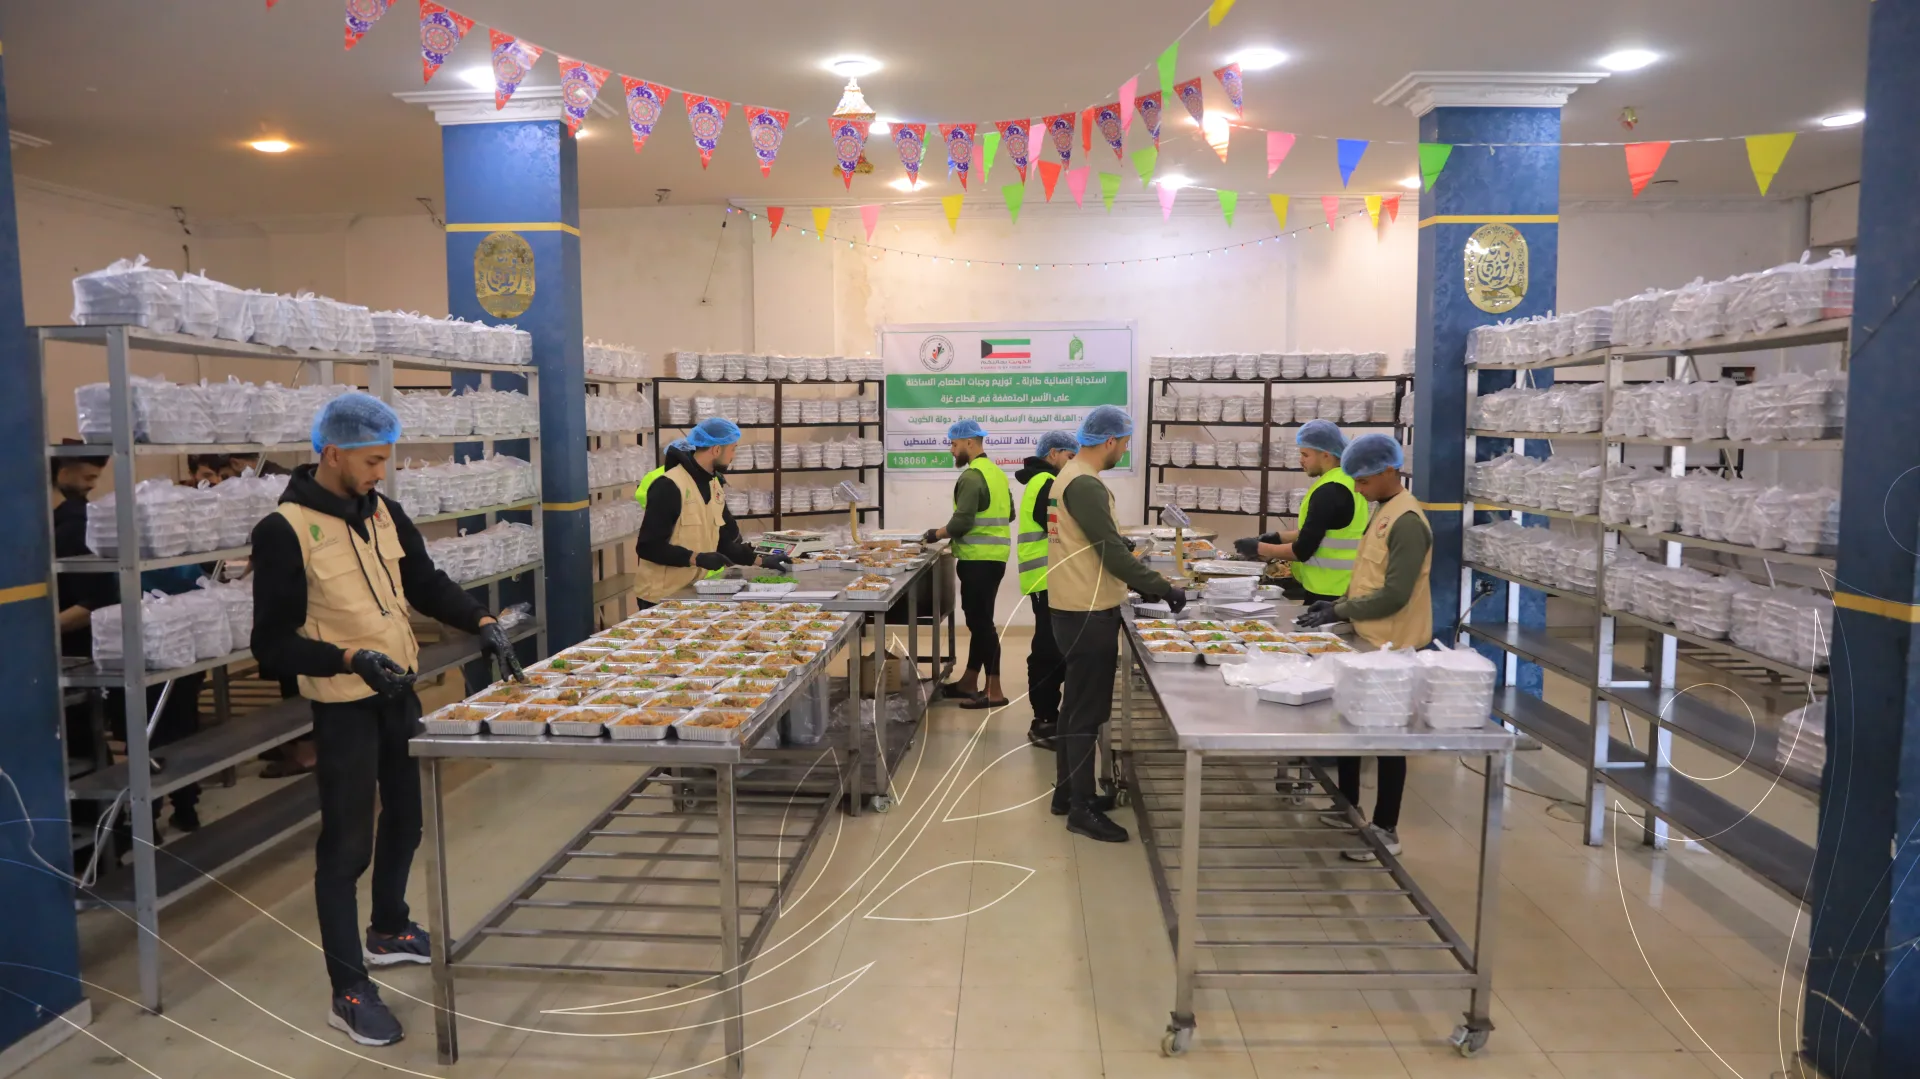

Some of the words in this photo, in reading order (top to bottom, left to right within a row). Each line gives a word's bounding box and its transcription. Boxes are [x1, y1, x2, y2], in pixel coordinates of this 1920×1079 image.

[938, 377, 966, 388] الطعام
[967, 377, 990, 388] وجبات
[991, 376, 1013, 387] توزيع
[1044, 376, 1073, 388] إنسانية
[1075, 375, 1107, 386] استجابة
[940, 393, 954, 404] غزة
[955, 393, 976, 404] قطاع
[977, 394, 990, 404] في
[1031, 391, 1052, 404] الأسر
[1053, 392, 1069, 402] على
[908, 415, 934, 425] الكويت
[935, 415, 951, 425] دولة
[989, 414, 1026, 424] الإسلامية
[1028, 414, 1052, 424] الخيرية
[903, 436, 937, 447] فلسطين
[985, 436, 1012, 447] للتنمية
[1014, 436, 1030, 446] الغد
[893, 456, 927, 466] 138060
